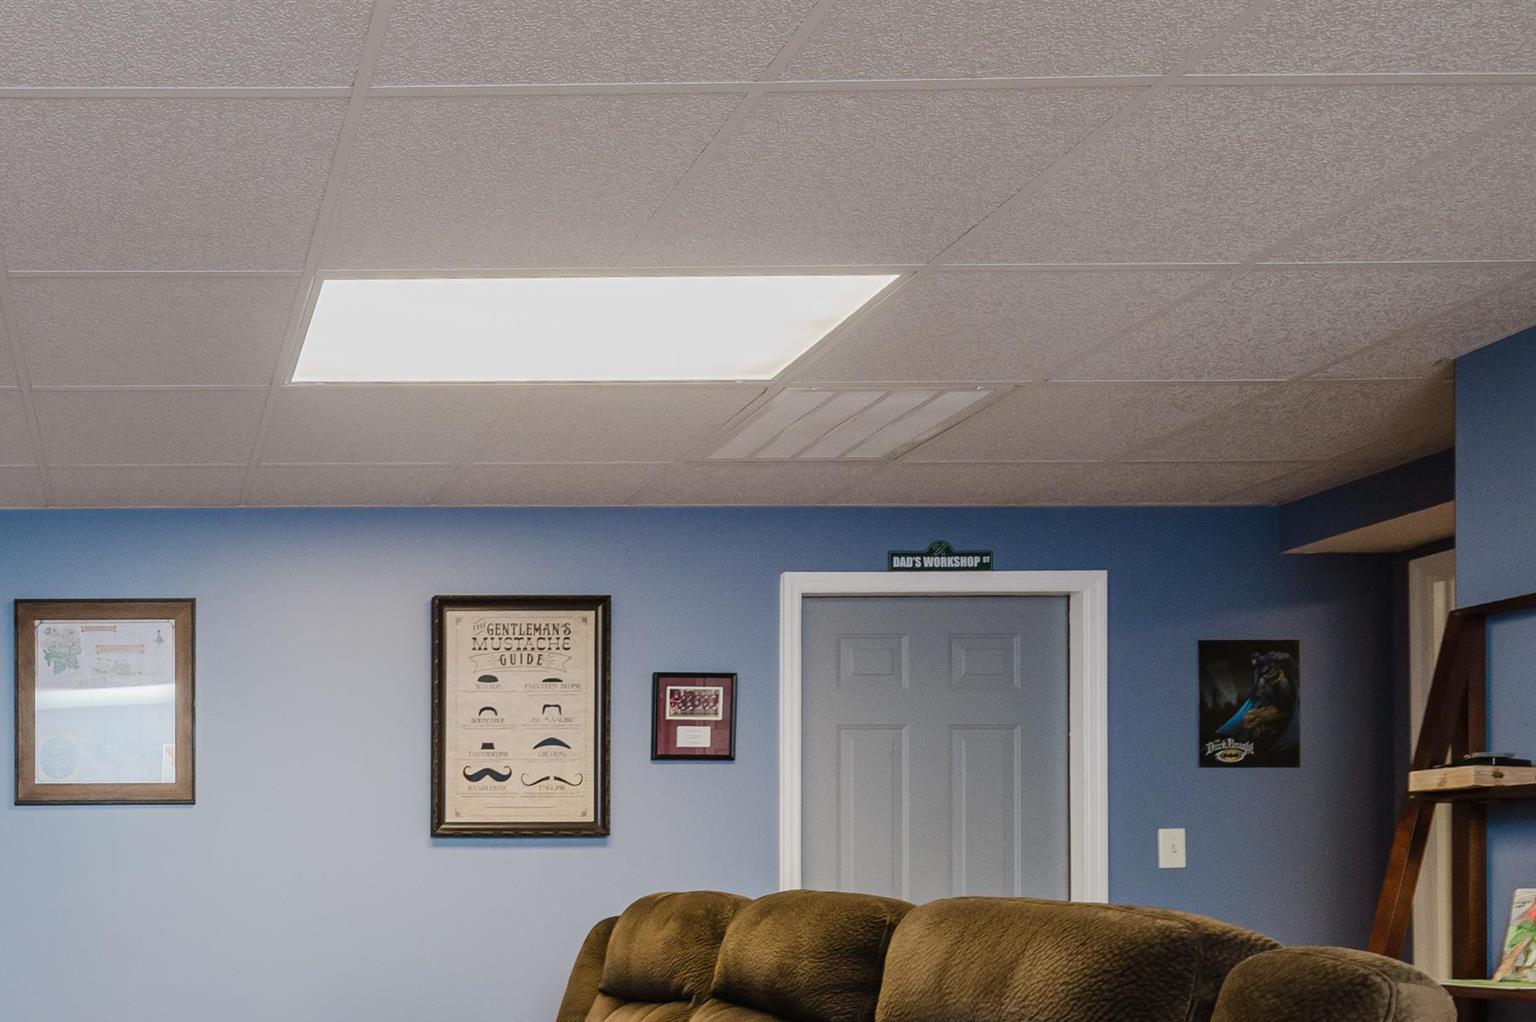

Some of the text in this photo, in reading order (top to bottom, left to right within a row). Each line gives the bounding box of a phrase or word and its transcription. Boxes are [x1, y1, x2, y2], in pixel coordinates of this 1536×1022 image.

[892, 556, 922, 568] DAD'S
[923, 555, 981, 568] WORKSHOP
[486, 622, 572, 636] GENTLEMAN'S
[471, 636, 572, 651] MUSTACHE
[499, 653, 544, 666] GUIDE
